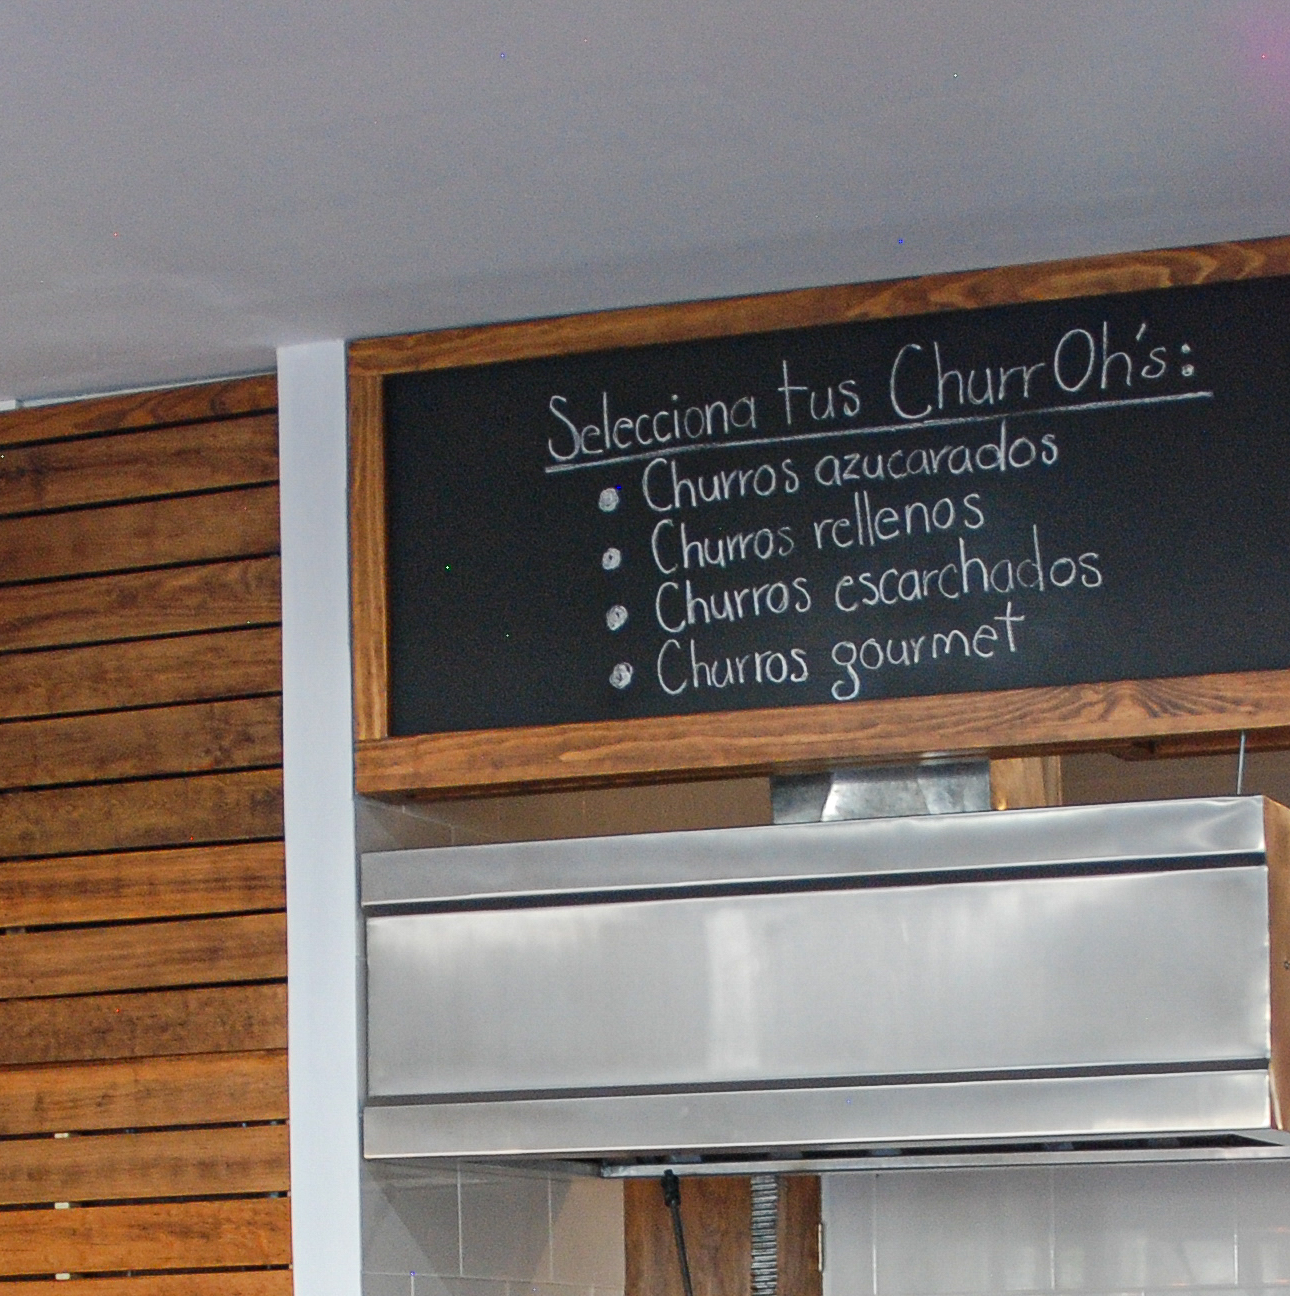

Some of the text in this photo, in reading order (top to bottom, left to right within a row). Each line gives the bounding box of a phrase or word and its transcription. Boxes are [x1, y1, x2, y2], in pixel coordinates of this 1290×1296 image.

[547, 392, 757, 461] Selecciona
[778, 359, 860, 424] tus
[641, 417, 1060, 514] Churros azucarados
[651, 490, 986, 577] Churros rellenos
[655, 525, 1104, 636] Churros escarchados
[657, 602, 1026, 703] Churros gourmet
